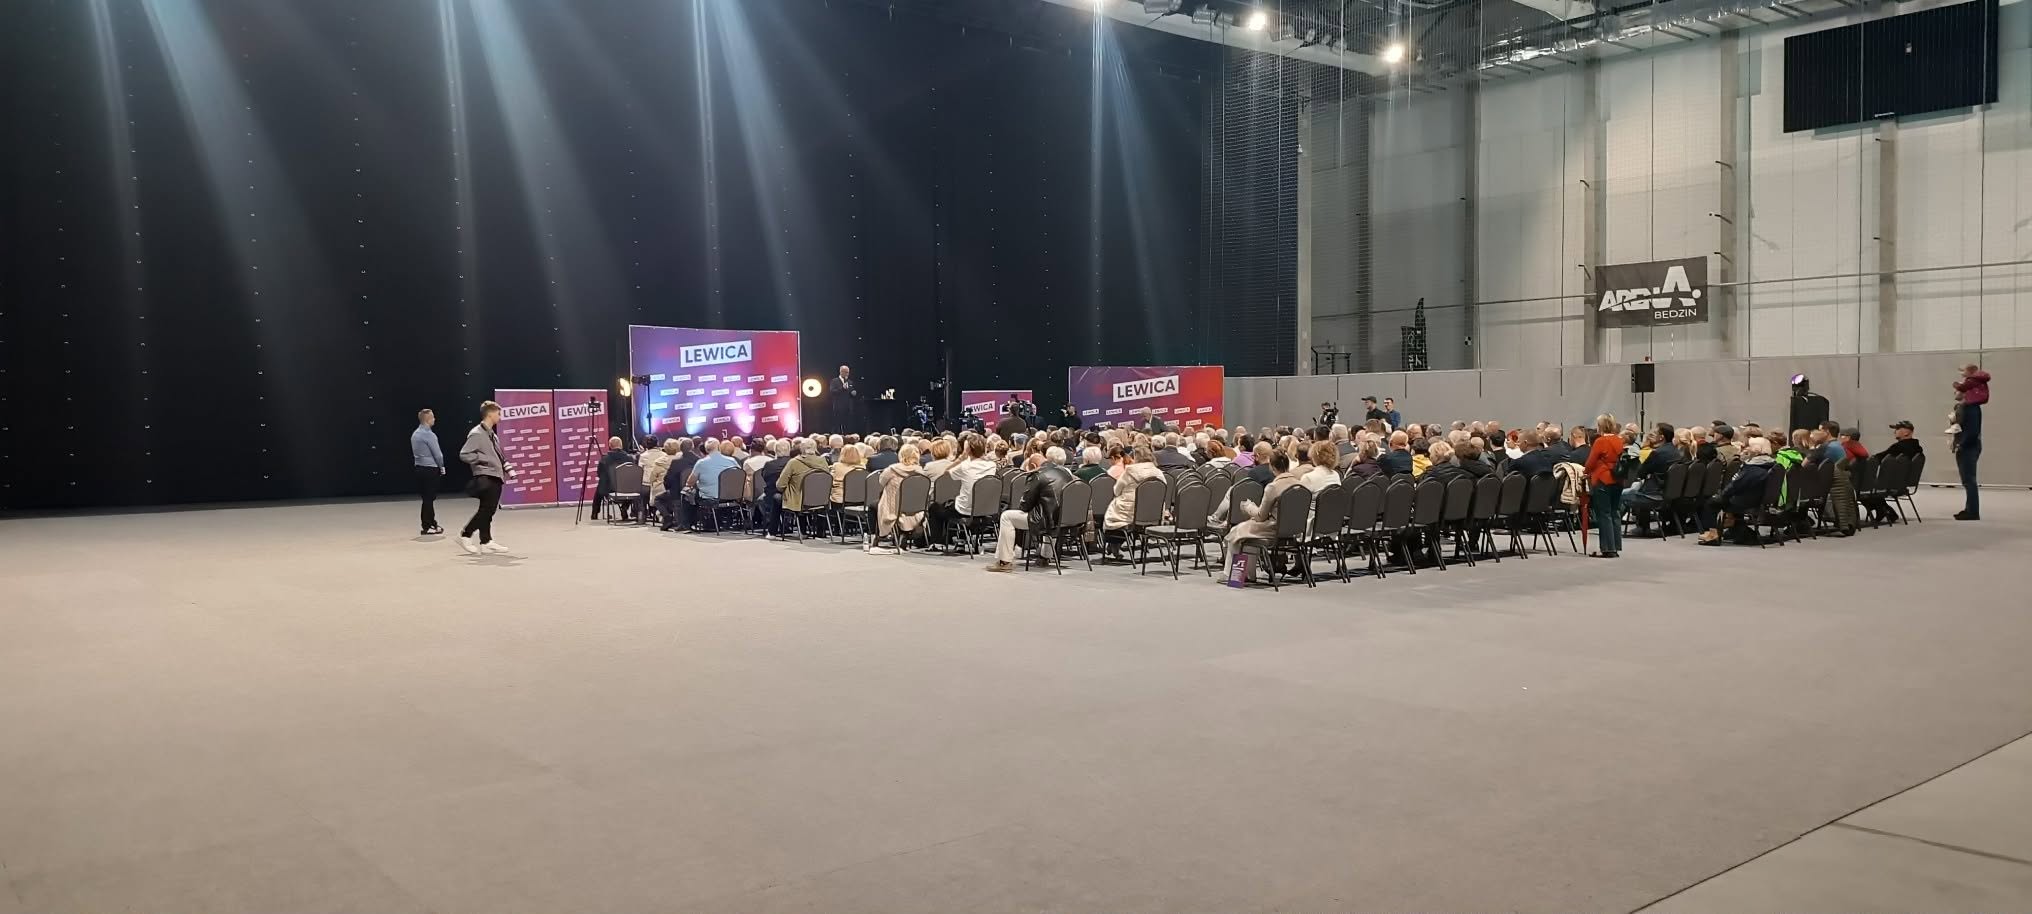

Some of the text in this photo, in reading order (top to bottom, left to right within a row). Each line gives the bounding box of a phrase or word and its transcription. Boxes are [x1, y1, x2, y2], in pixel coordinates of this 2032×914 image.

[685, 344, 748, 363] LEWICA
[1117, 379, 1175, 398] LEWICA
[503, 405, 547, 418] LEWICA
